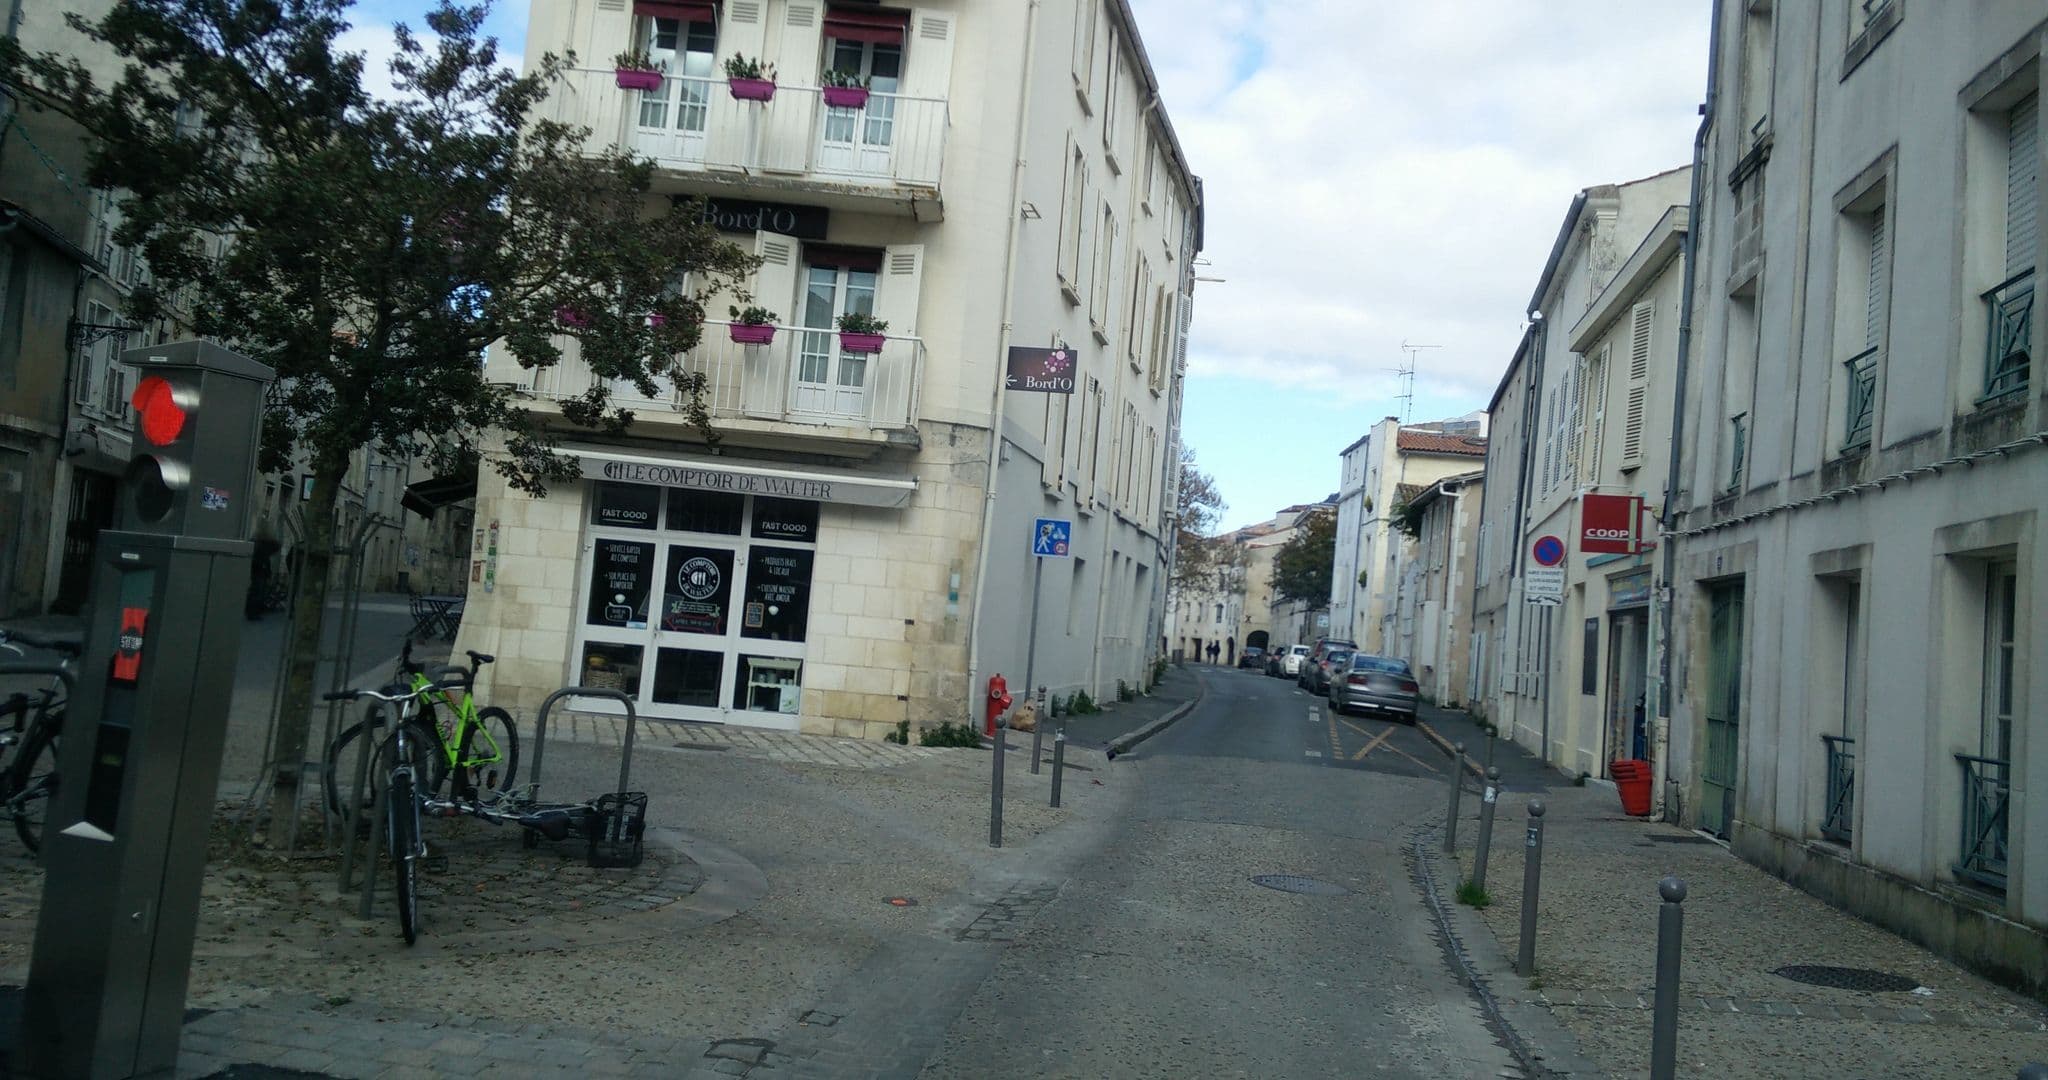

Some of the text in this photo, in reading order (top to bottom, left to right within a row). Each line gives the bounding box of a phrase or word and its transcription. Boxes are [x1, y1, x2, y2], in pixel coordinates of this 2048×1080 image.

[701, 201, 796, 232] Bord'O
[1025, 375, 1073, 391] Bord'O
[625, 464, 832, 498] LE COMPTOIR DE WALTER
[602, 508, 648, 520] FAST GOOD
[762, 521, 807, 533] FAST GOOD
[1586, 528, 1629, 537] COOP
